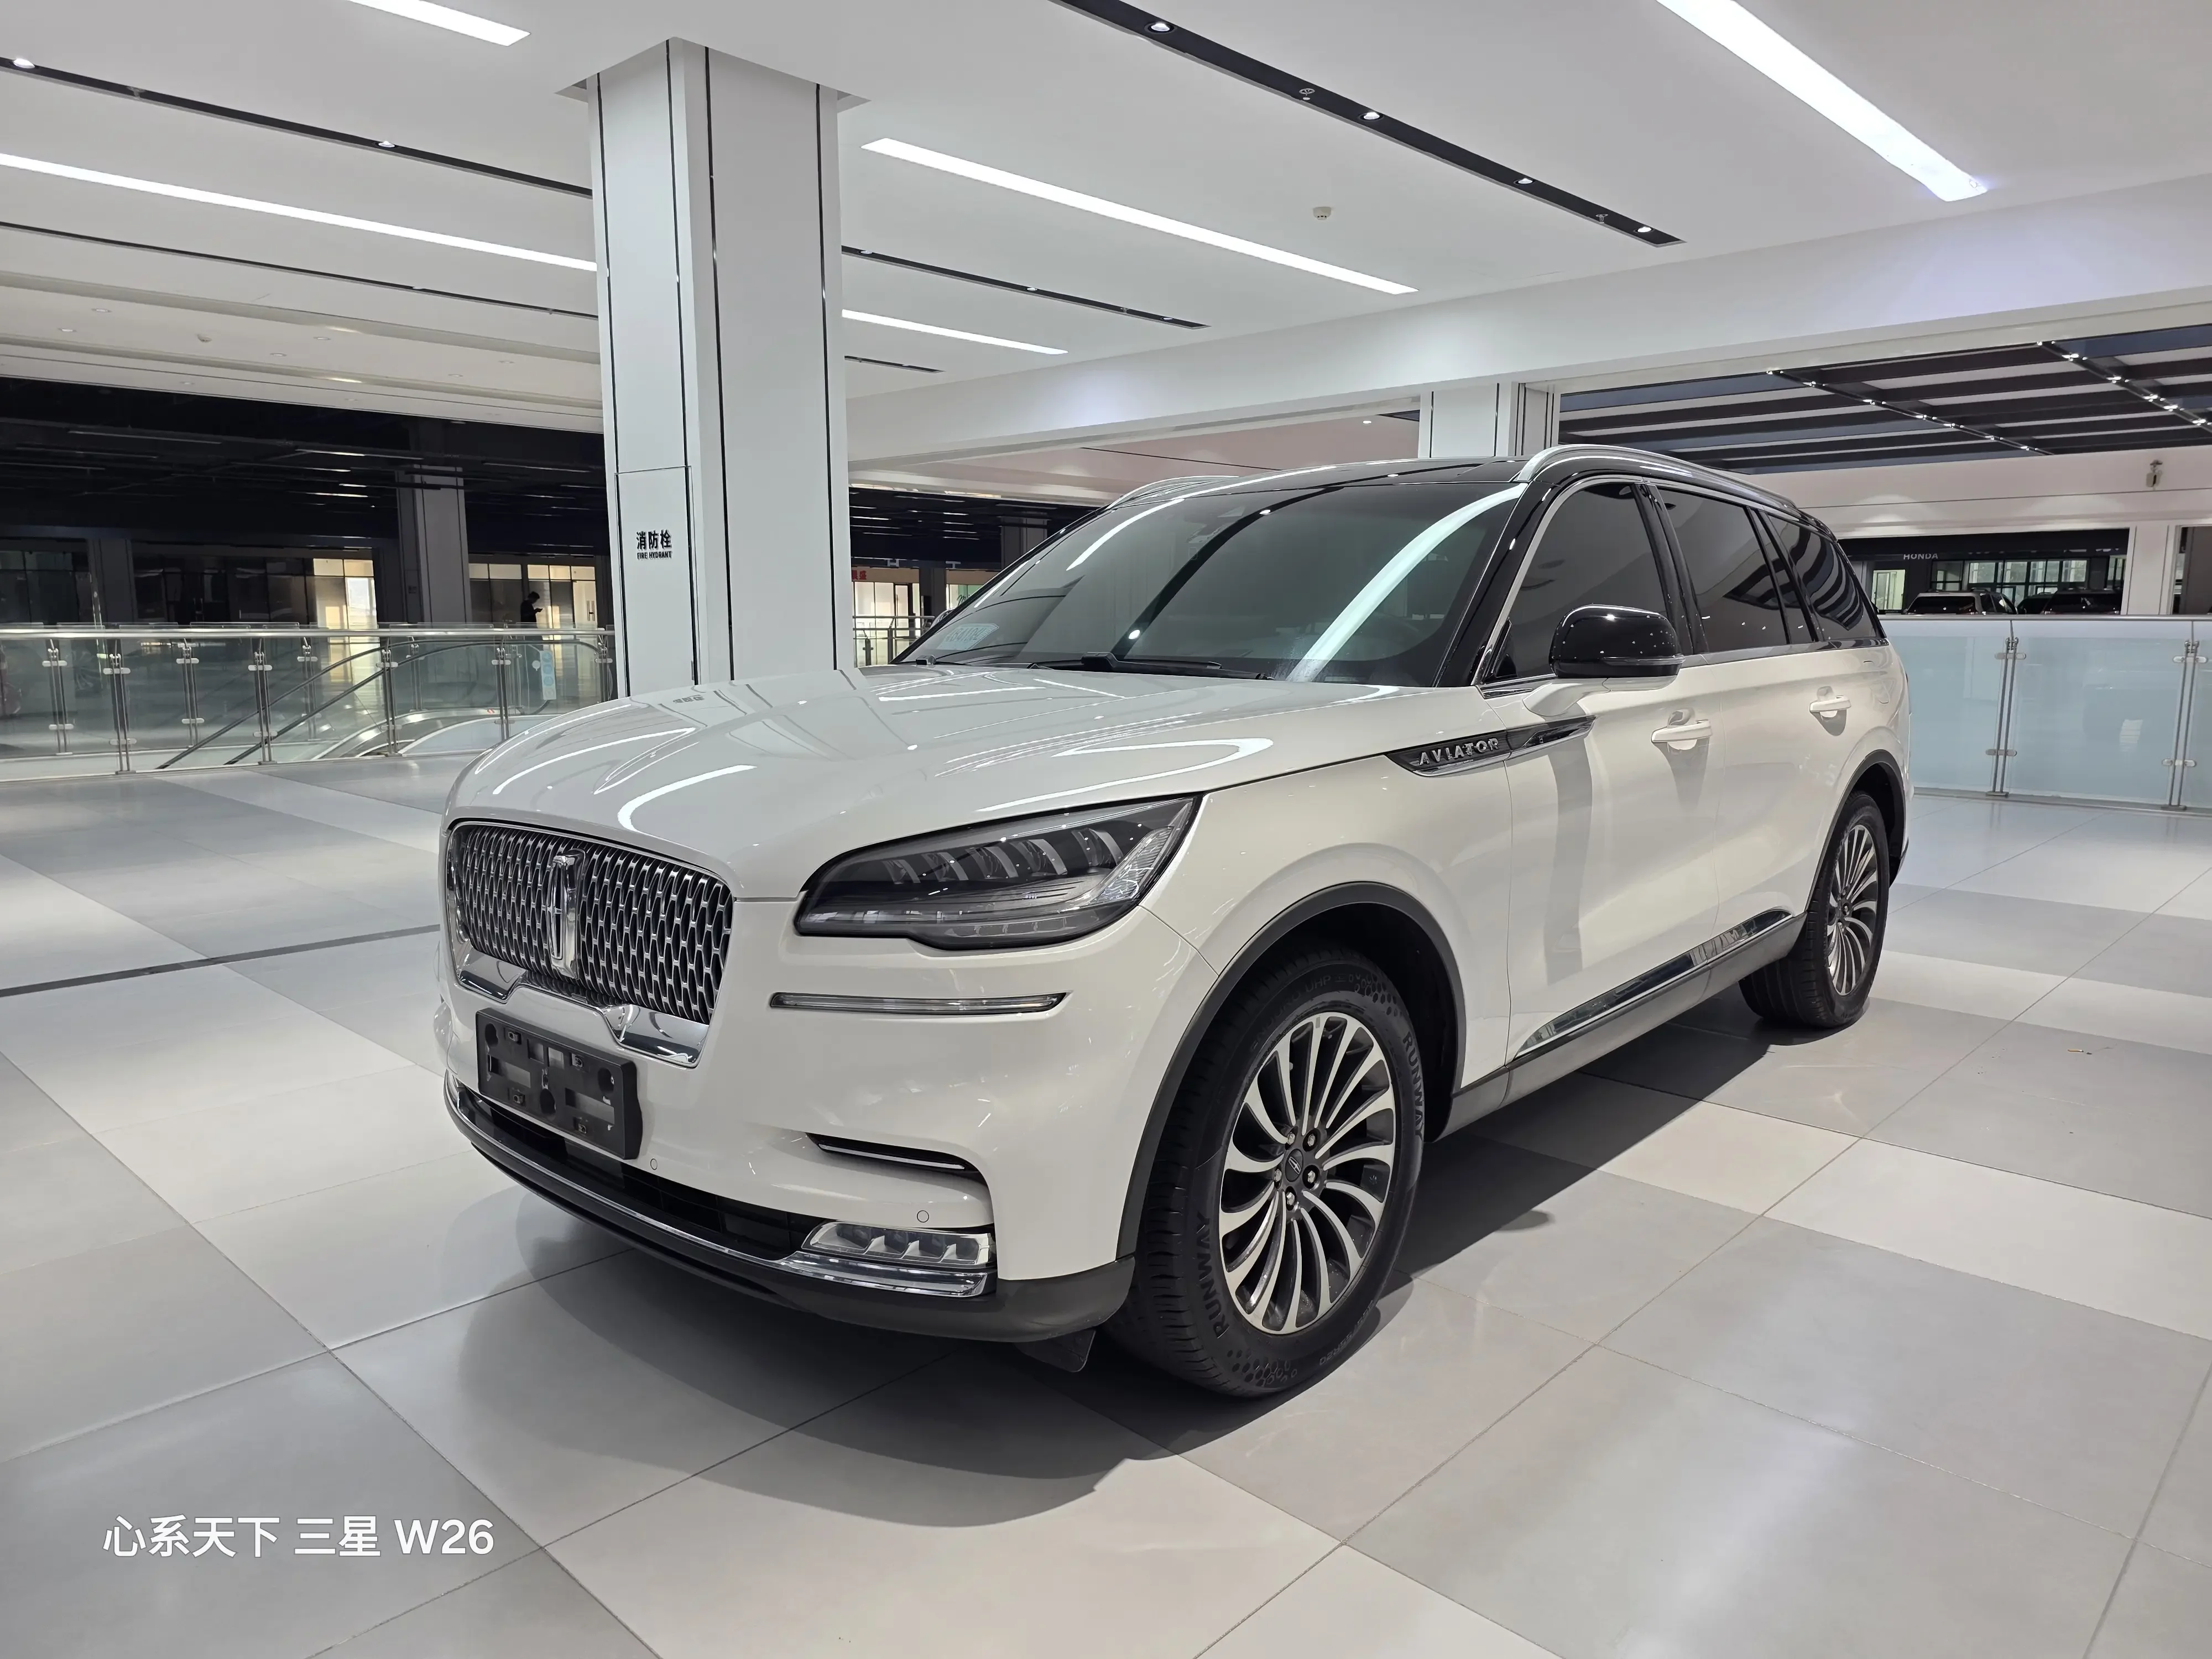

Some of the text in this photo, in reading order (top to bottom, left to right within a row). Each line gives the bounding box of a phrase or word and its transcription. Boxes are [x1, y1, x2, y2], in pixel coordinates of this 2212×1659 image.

[637, 529, 672, 550] 消防栓
[649, 551, 672, 559] HYDRANT
[1419, 738, 1499, 766] AVIATOR
[1305, 975, 1331, 992] UHP
[1402, 1031, 1423, 1141] RUNWAY
[1196, 1211, 1230, 1338] RUNWAY
